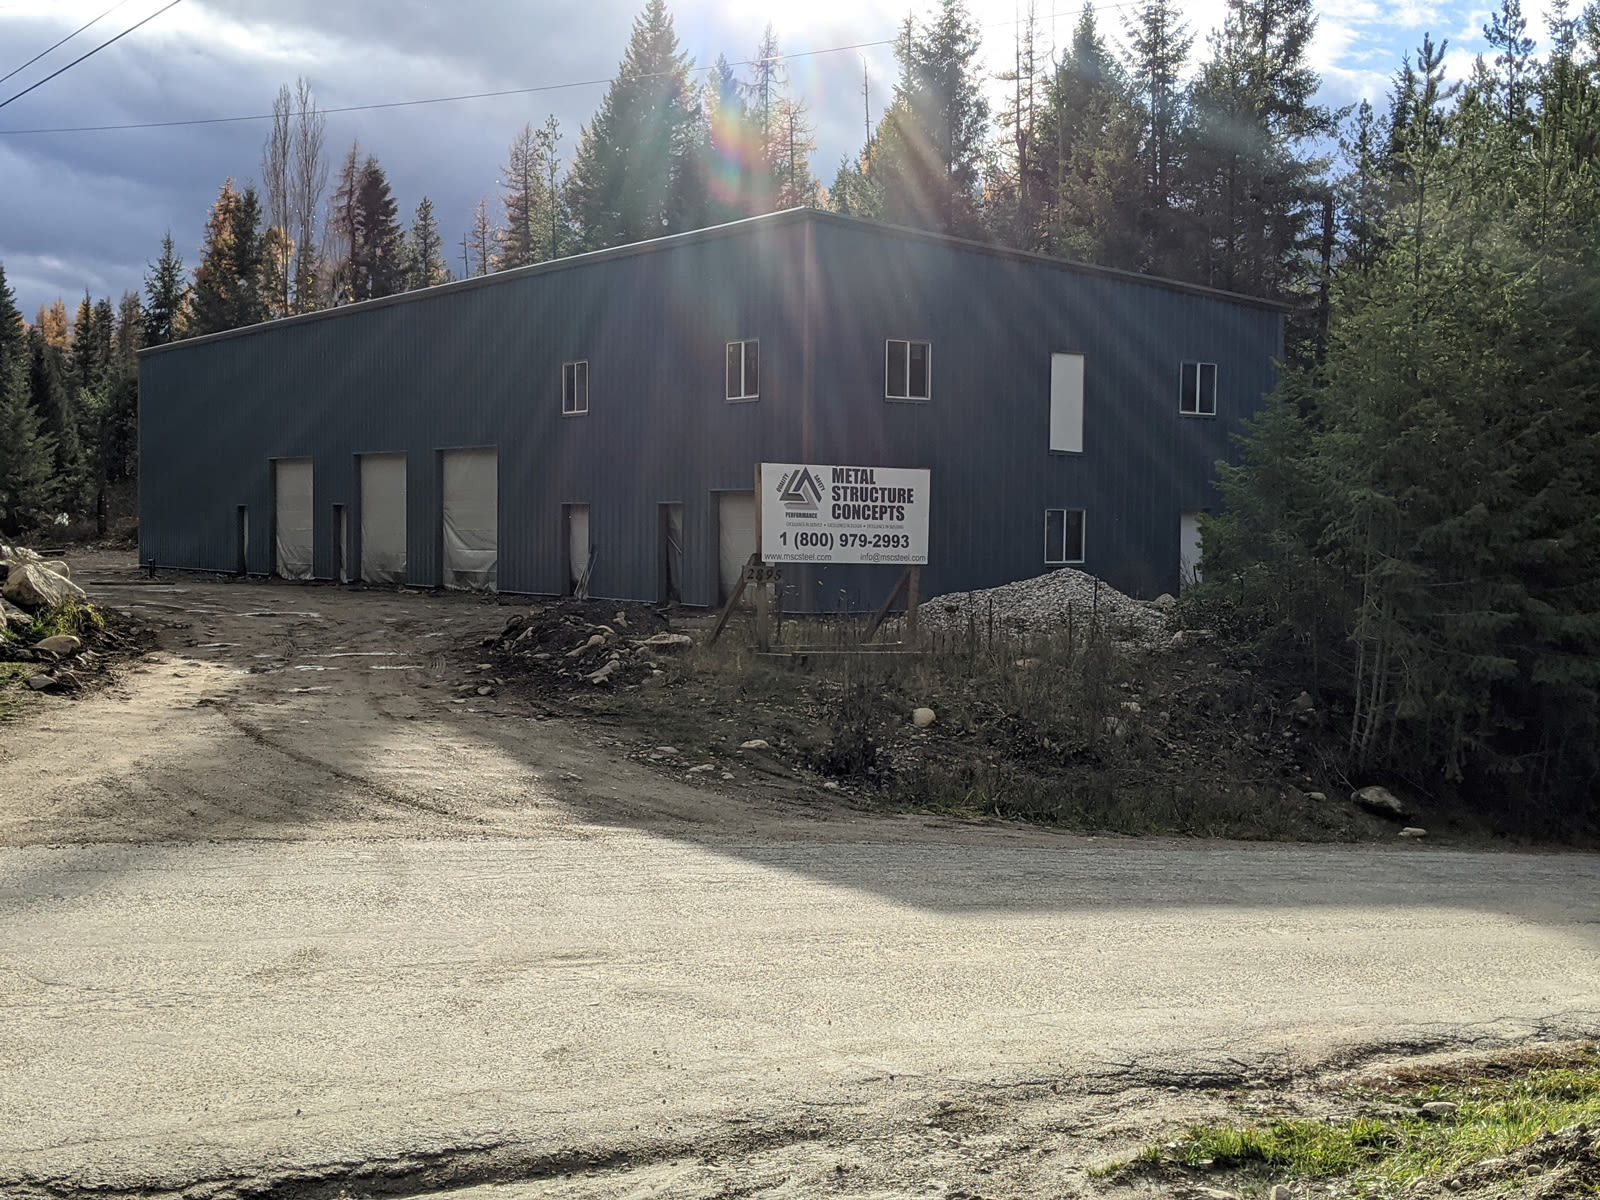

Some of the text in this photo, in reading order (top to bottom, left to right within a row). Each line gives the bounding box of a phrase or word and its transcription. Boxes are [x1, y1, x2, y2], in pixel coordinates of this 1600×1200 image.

[777, 474, 789, 493] QUALITY
[832, 467, 876, 485] METAL
[832, 485, 914, 504] STRUCTURE
[785, 511, 818, 519] PERFORMANCE
[831, 503, 905, 521] CONCEPTS
[779, 532, 910, 550] 1 (800) 979-2993
[765, 552, 832, 561] www.mscsteel.com
[860, 553, 926, 562] info@mscsteel.com
[747, 568, 782, 582] 2895
